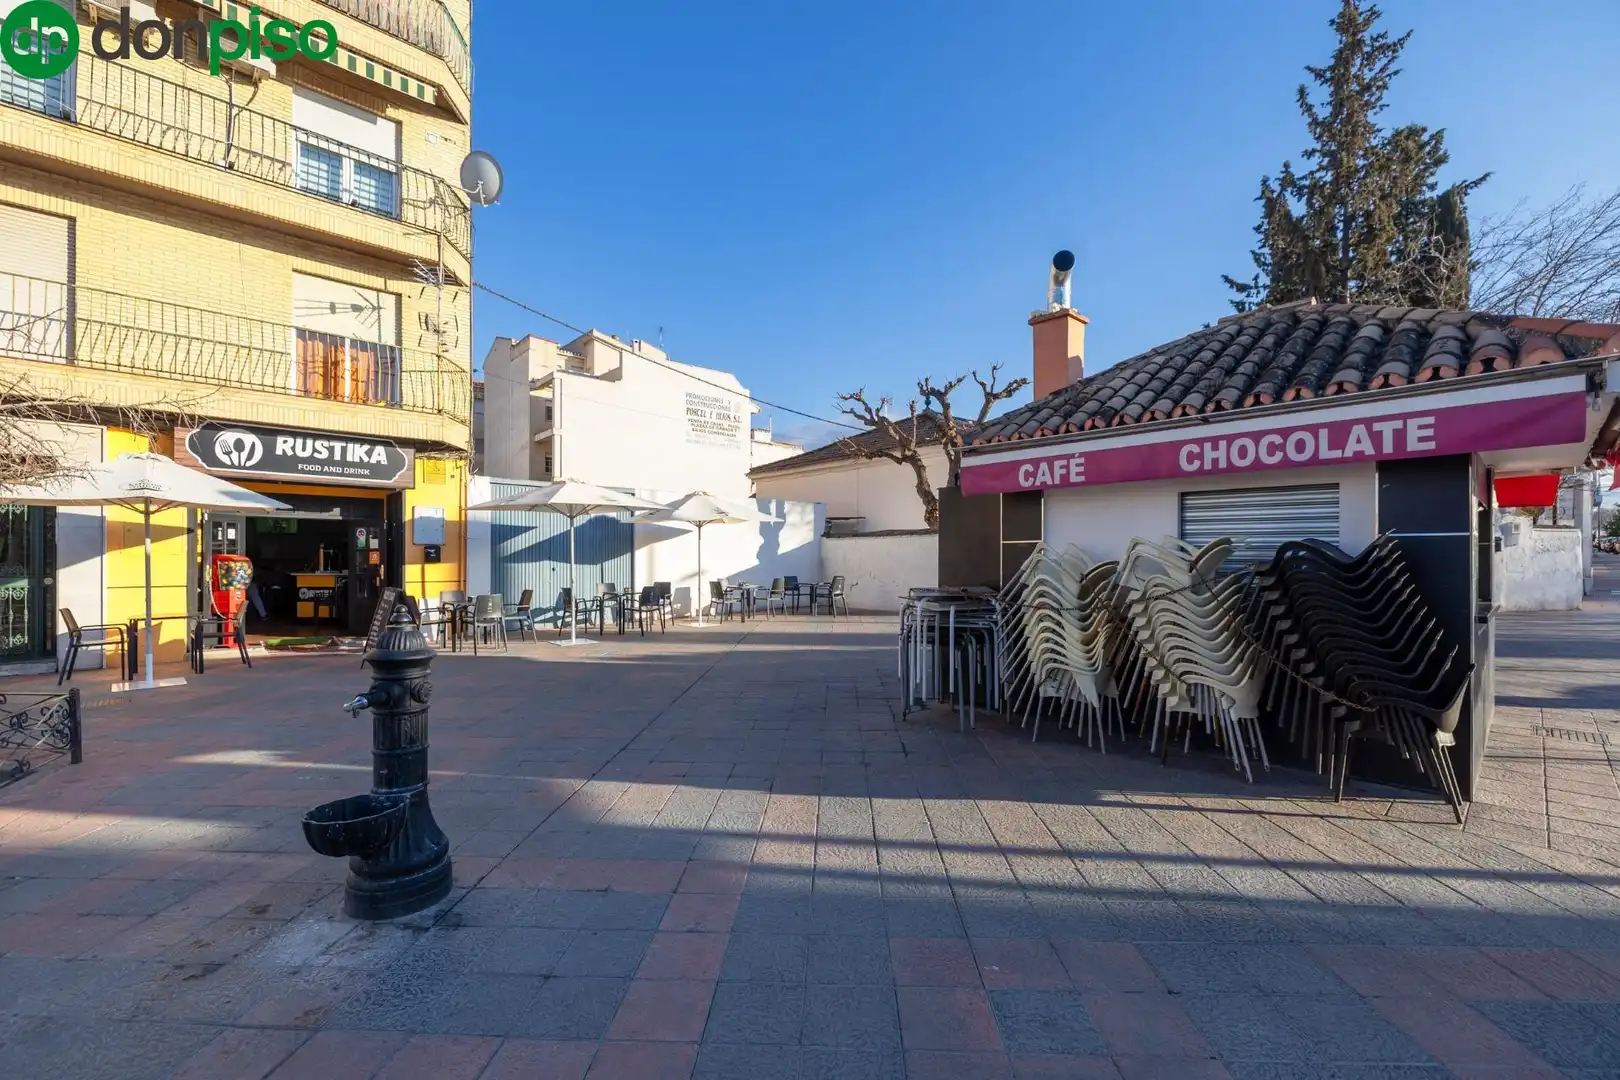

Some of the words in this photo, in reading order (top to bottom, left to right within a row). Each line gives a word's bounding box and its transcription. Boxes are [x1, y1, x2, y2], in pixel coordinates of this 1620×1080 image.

[686, 392, 724, 404] PROMOCIONES
[686, 400, 731, 412] CONSTRUCCIONES
[275, 435, 388, 465] RUSTIKA
[1178, 415, 1437, 473] CHOCOLATE
[298, 464, 321, 472] FOOD
[323, 466, 342, 474] AND
[343, 466, 370, 476] DRINK
[1018, 453, 1086, 487] CAFÉ
